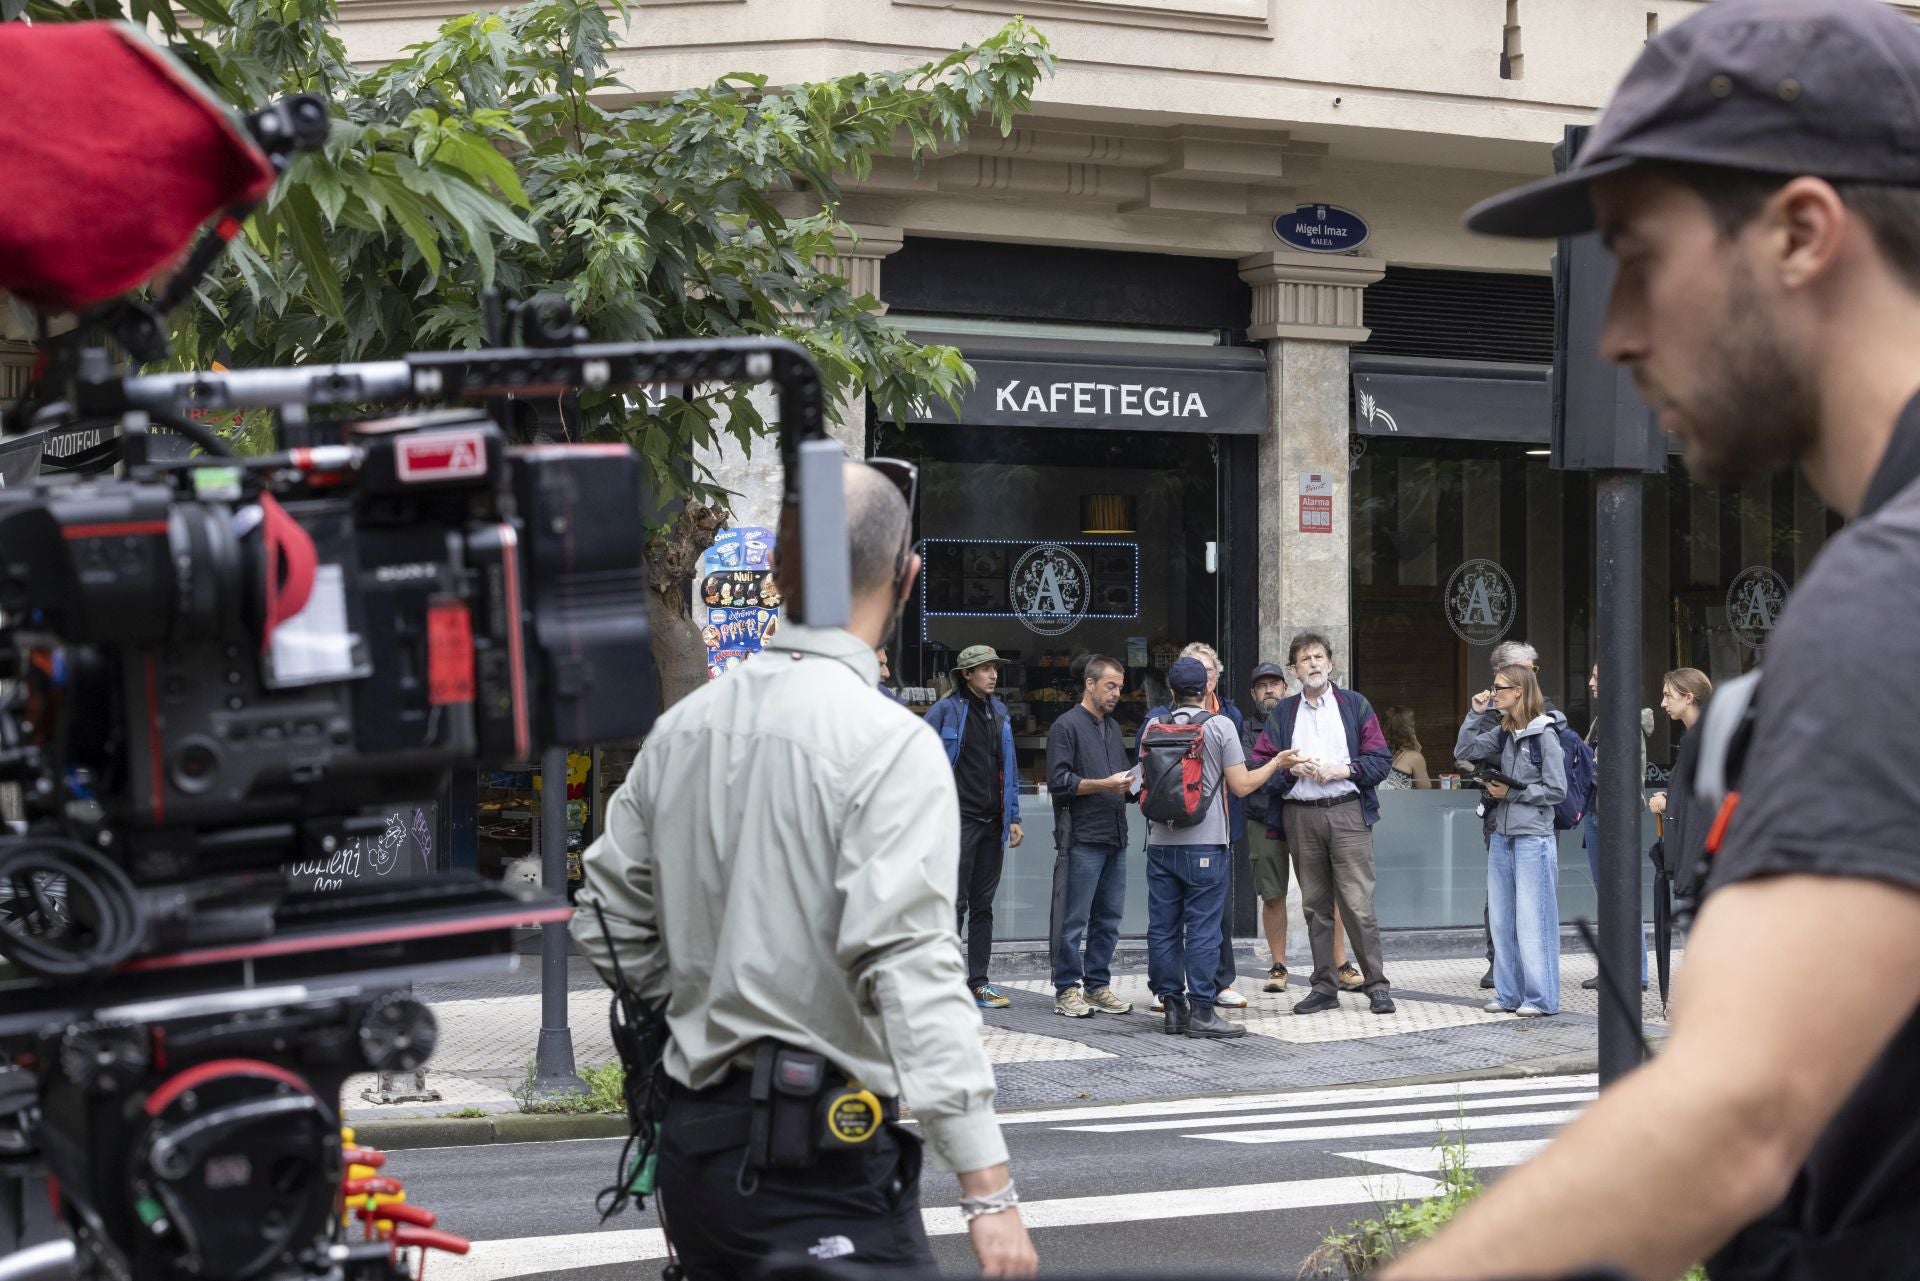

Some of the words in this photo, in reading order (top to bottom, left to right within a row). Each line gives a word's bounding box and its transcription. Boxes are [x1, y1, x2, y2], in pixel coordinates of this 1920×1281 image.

[1296, 224, 1321, 236] Migel
[1324, 225, 1348, 237] Imaz
[1311, 238, 1332, 246] KALEA
[996, 380, 1209, 418] KAFETEGIA
[1302, 497, 1330, 506] Alarma
